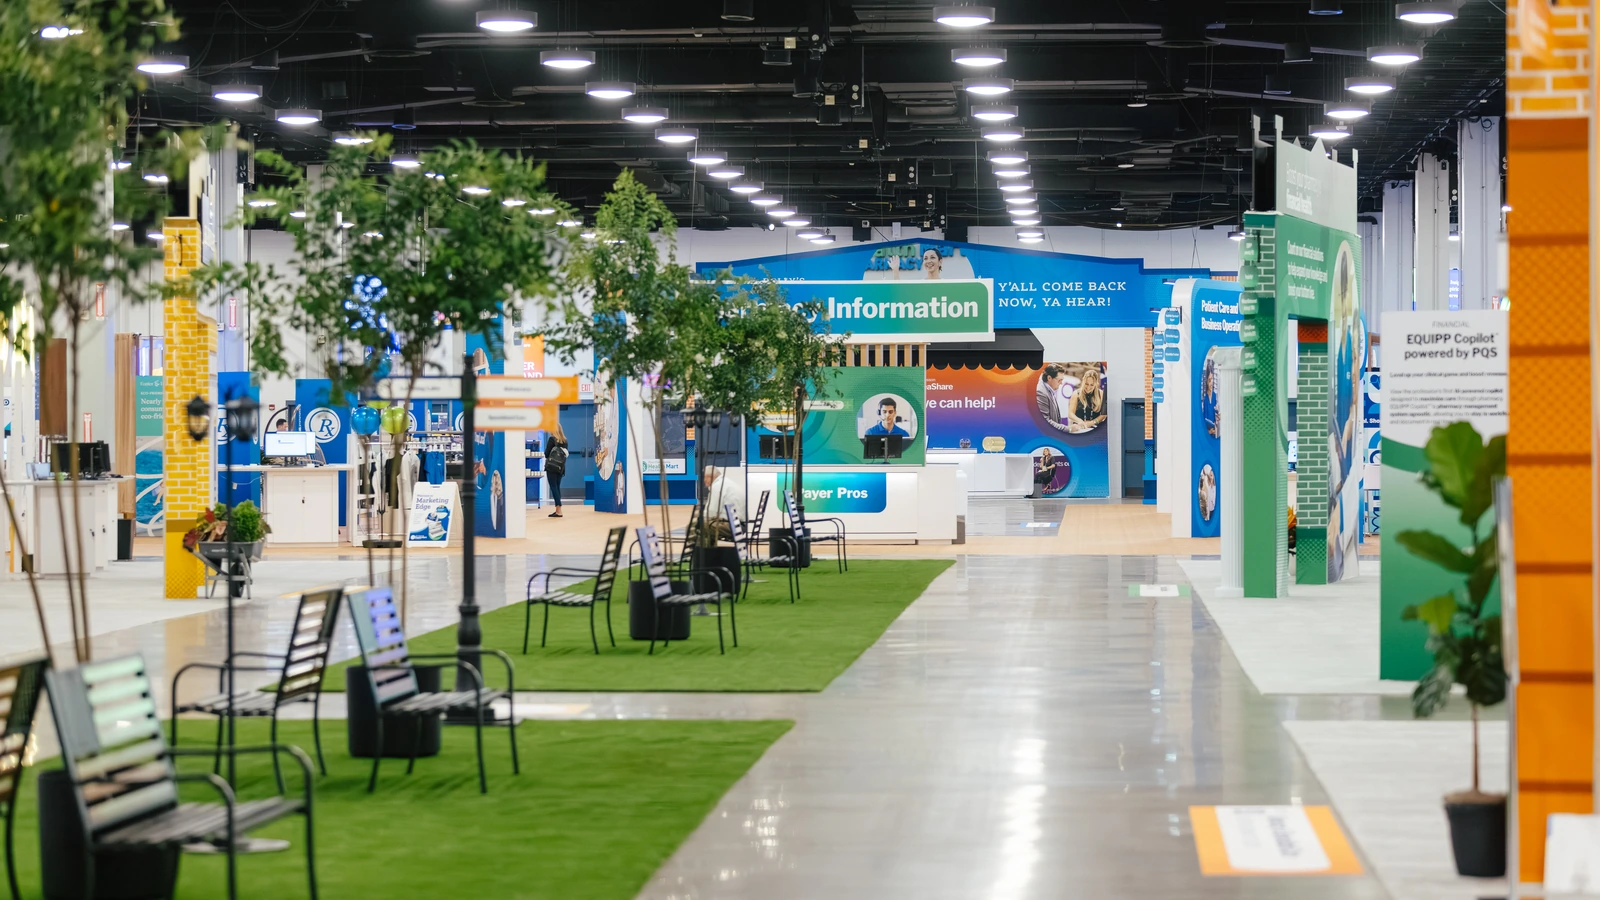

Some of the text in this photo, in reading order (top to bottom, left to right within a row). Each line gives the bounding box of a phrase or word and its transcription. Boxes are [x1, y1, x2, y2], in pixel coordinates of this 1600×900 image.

[998, 282, 1126, 291] Y'ALL COME BACK
[828, 296, 978, 319] Information
[998, 297, 1111, 308] NOW, YA HEAR!
[1202, 300, 1218, 313] Patient
[1219, 301, 1229, 314] Care
[1230, 302, 1238, 314] and
[1202, 317, 1222, 330] Business
[1407, 334, 1450, 345] EQUIPP
[1404, 347, 1498, 360] powered by PQS
[939, 399, 962, 408] can
[964, 397, 996, 410] help!
[837, 487, 868, 498] Pros
